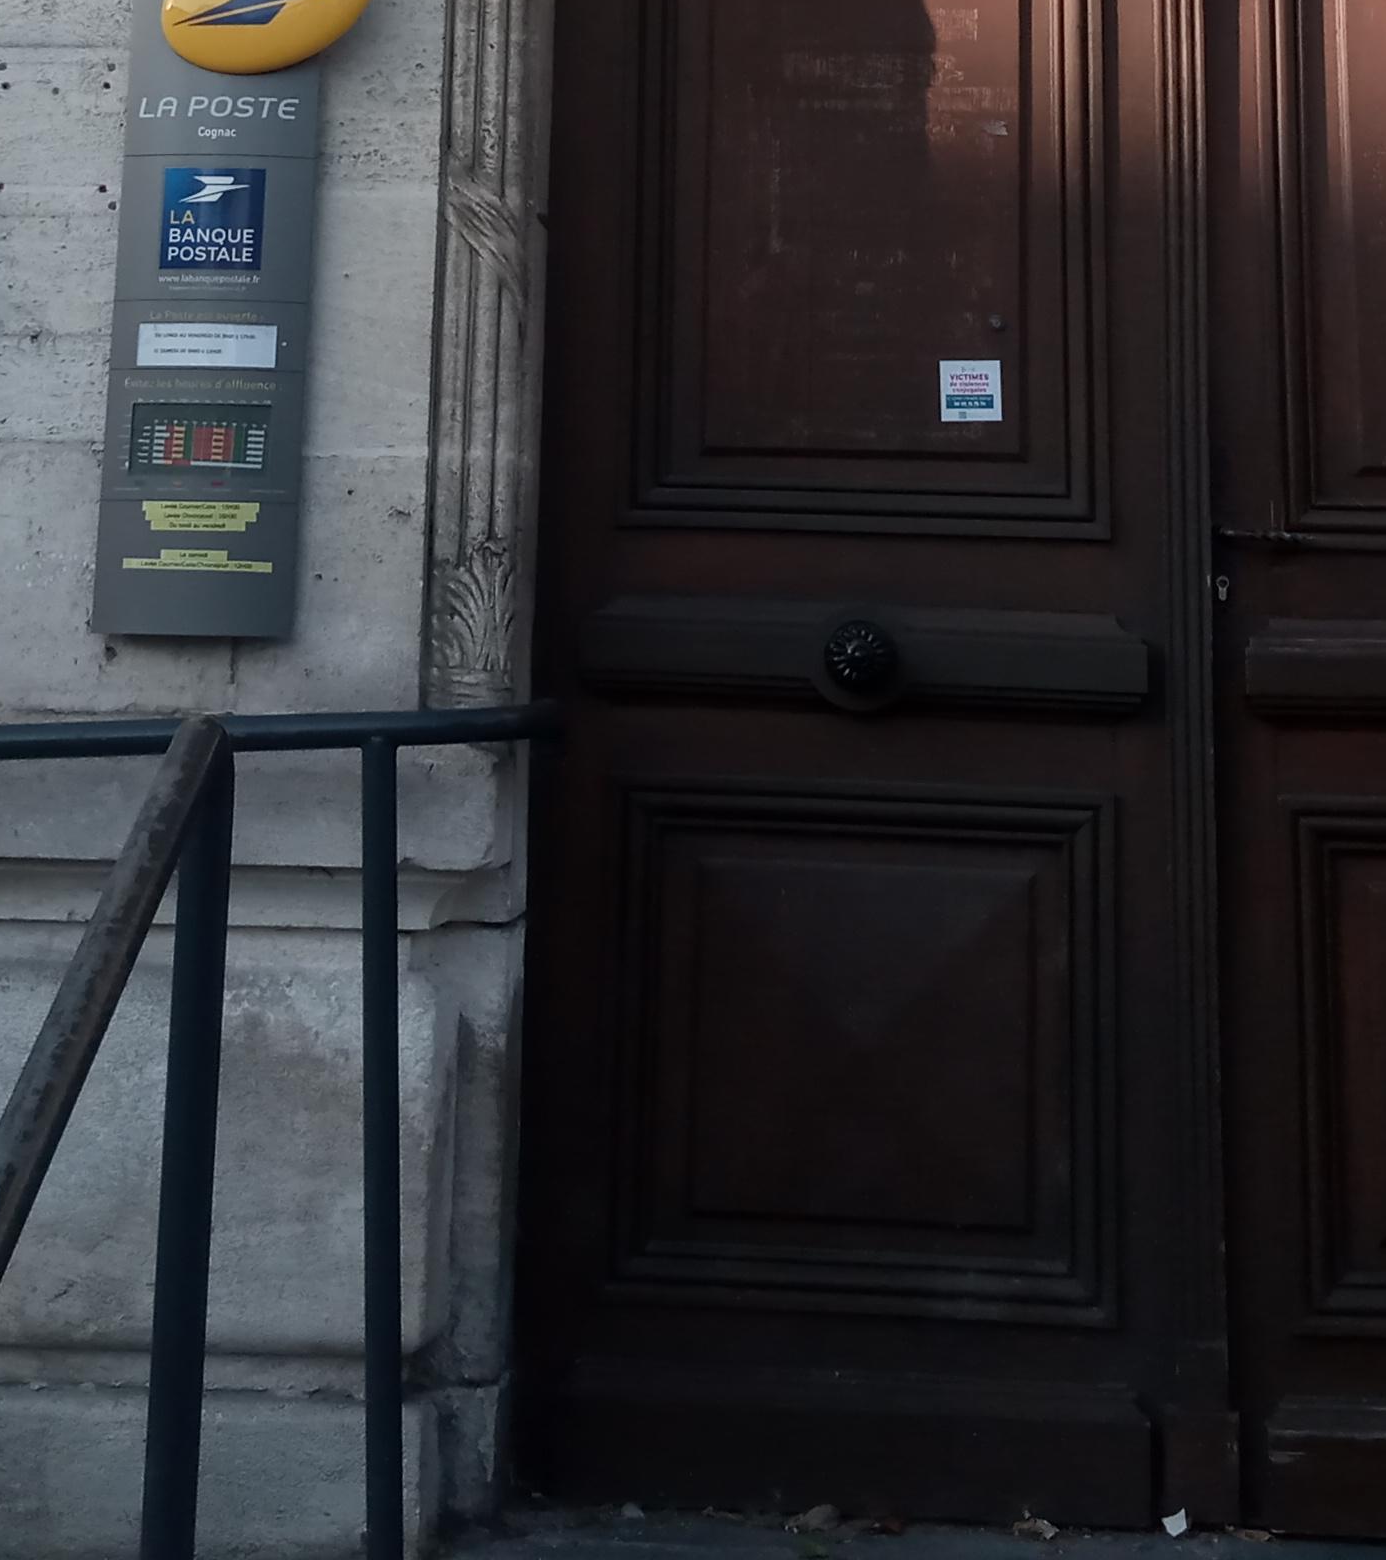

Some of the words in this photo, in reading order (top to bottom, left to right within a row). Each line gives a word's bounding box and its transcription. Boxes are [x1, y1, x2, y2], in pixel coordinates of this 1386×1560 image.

[139, 96, 178, 118] LA
[187, 96, 300, 120] POSTE
[198, 126, 237, 139] Cognac
[170, 210, 195, 224] LA
[169, 228, 255, 245] BANQUE
[168, 246, 254, 262] POSTALE
[949, 373, 989, 381] VICTIMES
